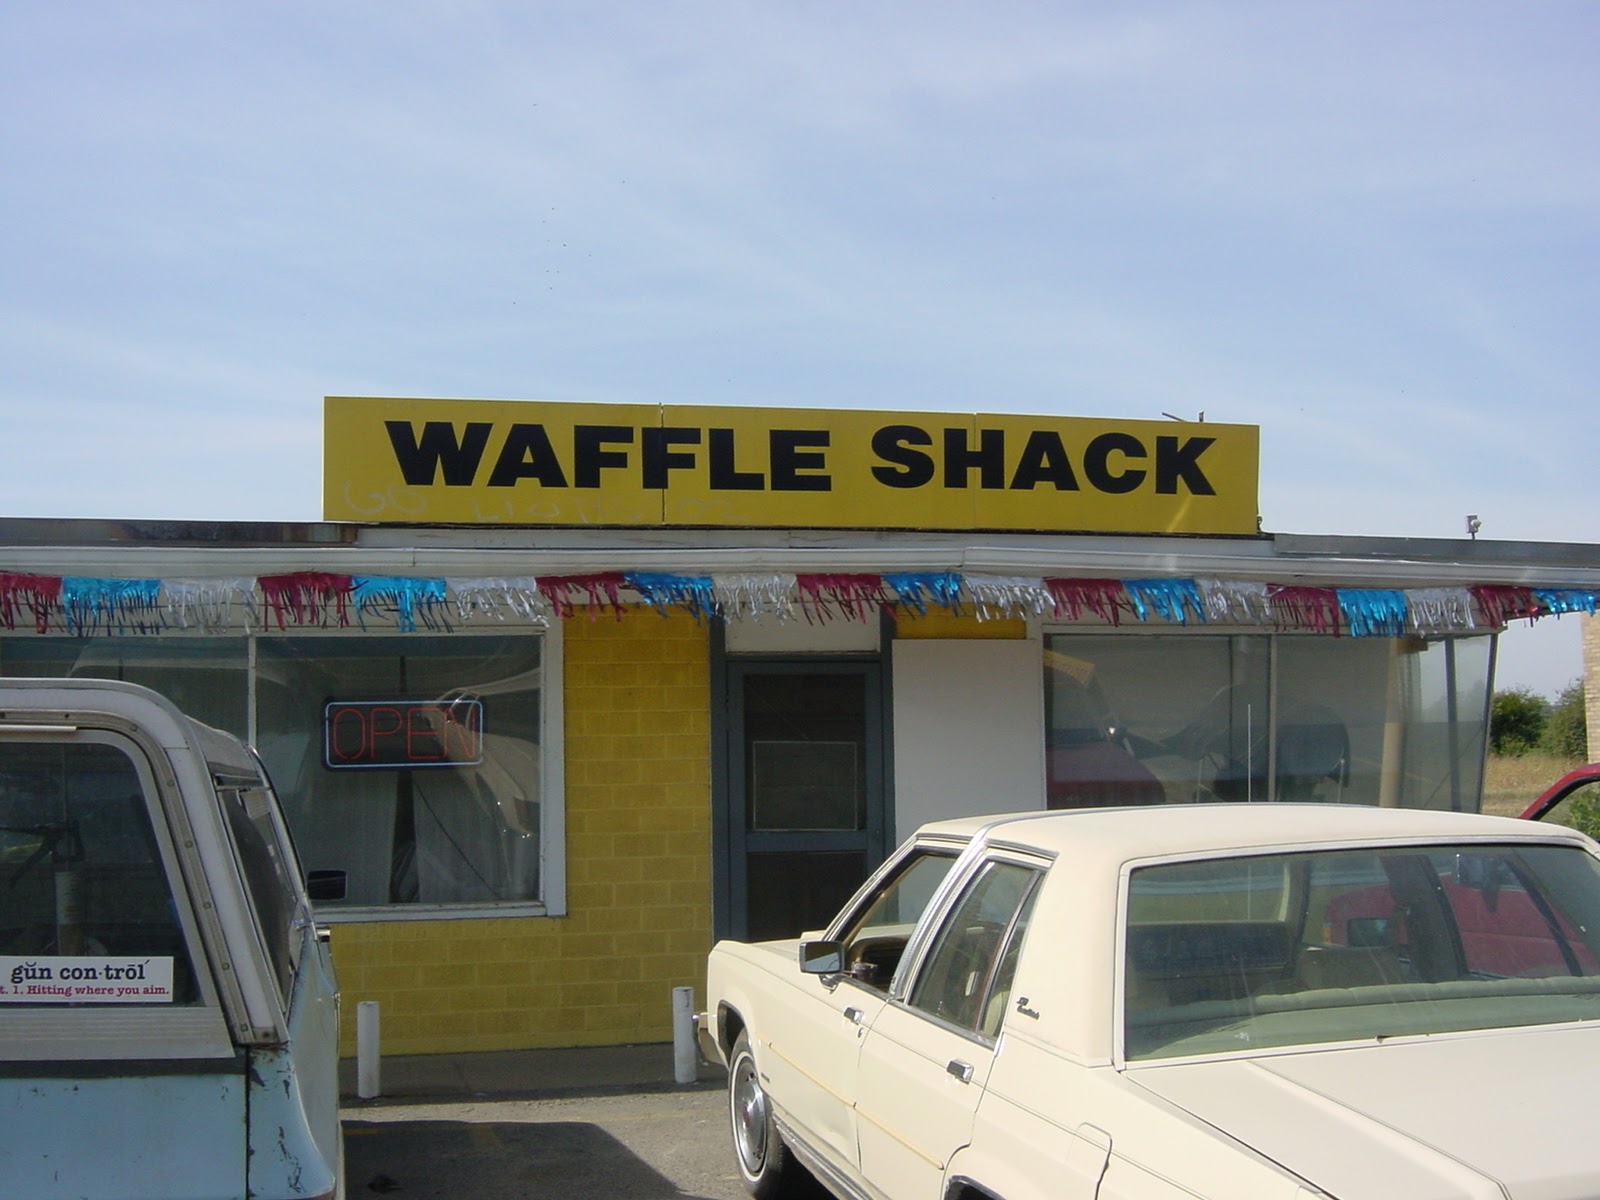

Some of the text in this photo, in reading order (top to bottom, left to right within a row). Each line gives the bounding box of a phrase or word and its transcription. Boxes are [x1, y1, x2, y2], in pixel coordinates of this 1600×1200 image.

[384, 420, 1218, 496] WAFFLE SHACK
[333, 706, 477, 760] OPEN
[13, 985, 24, 995] 1.
[27, 984, 72, 997] Hitting
[75, 985, 114, 995] where
[117, 987, 140, 998] you
[142, 985, 169, 995] aim.
